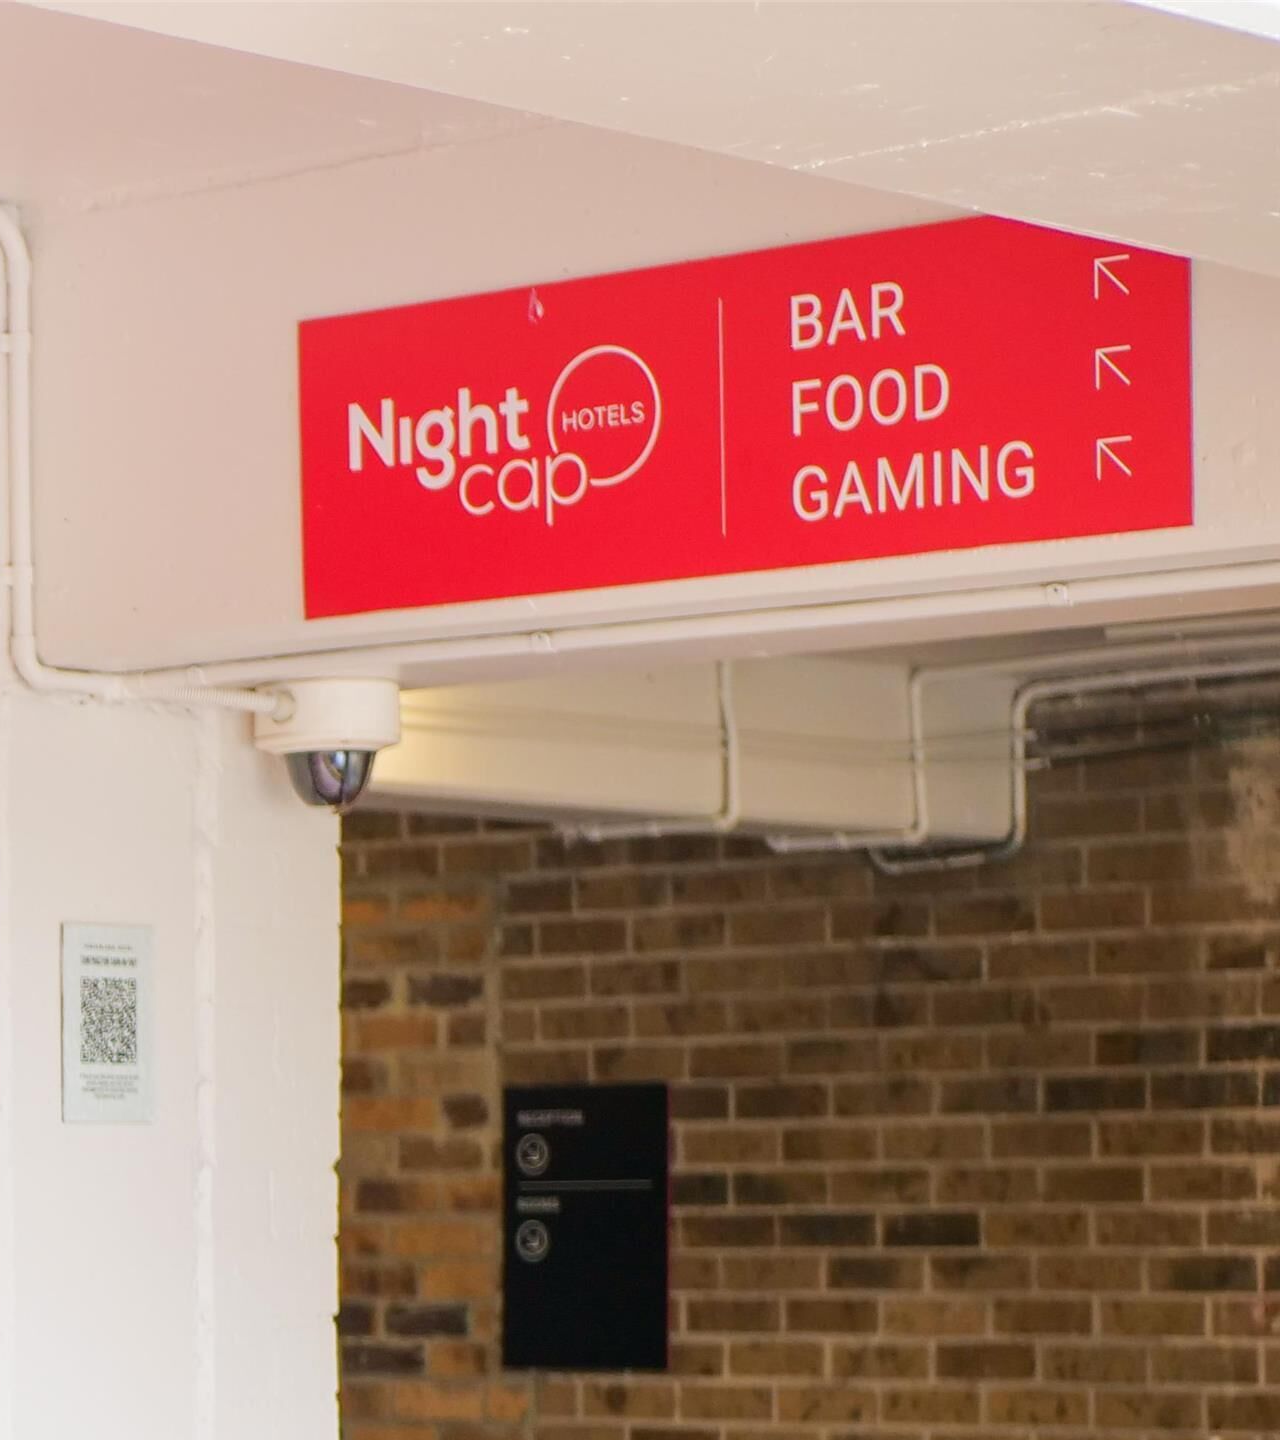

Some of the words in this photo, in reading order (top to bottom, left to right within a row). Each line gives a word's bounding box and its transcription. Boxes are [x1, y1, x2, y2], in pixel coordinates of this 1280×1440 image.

[790, 282, 906, 350] BAR
[562, 401, 645, 433] HOTELS
[792, 363, 949, 437] FOOD
[348, 387, 529, 490] Night
[458, 449, 588, 526] cap
[792, 440, 1035, 522] GAMING
